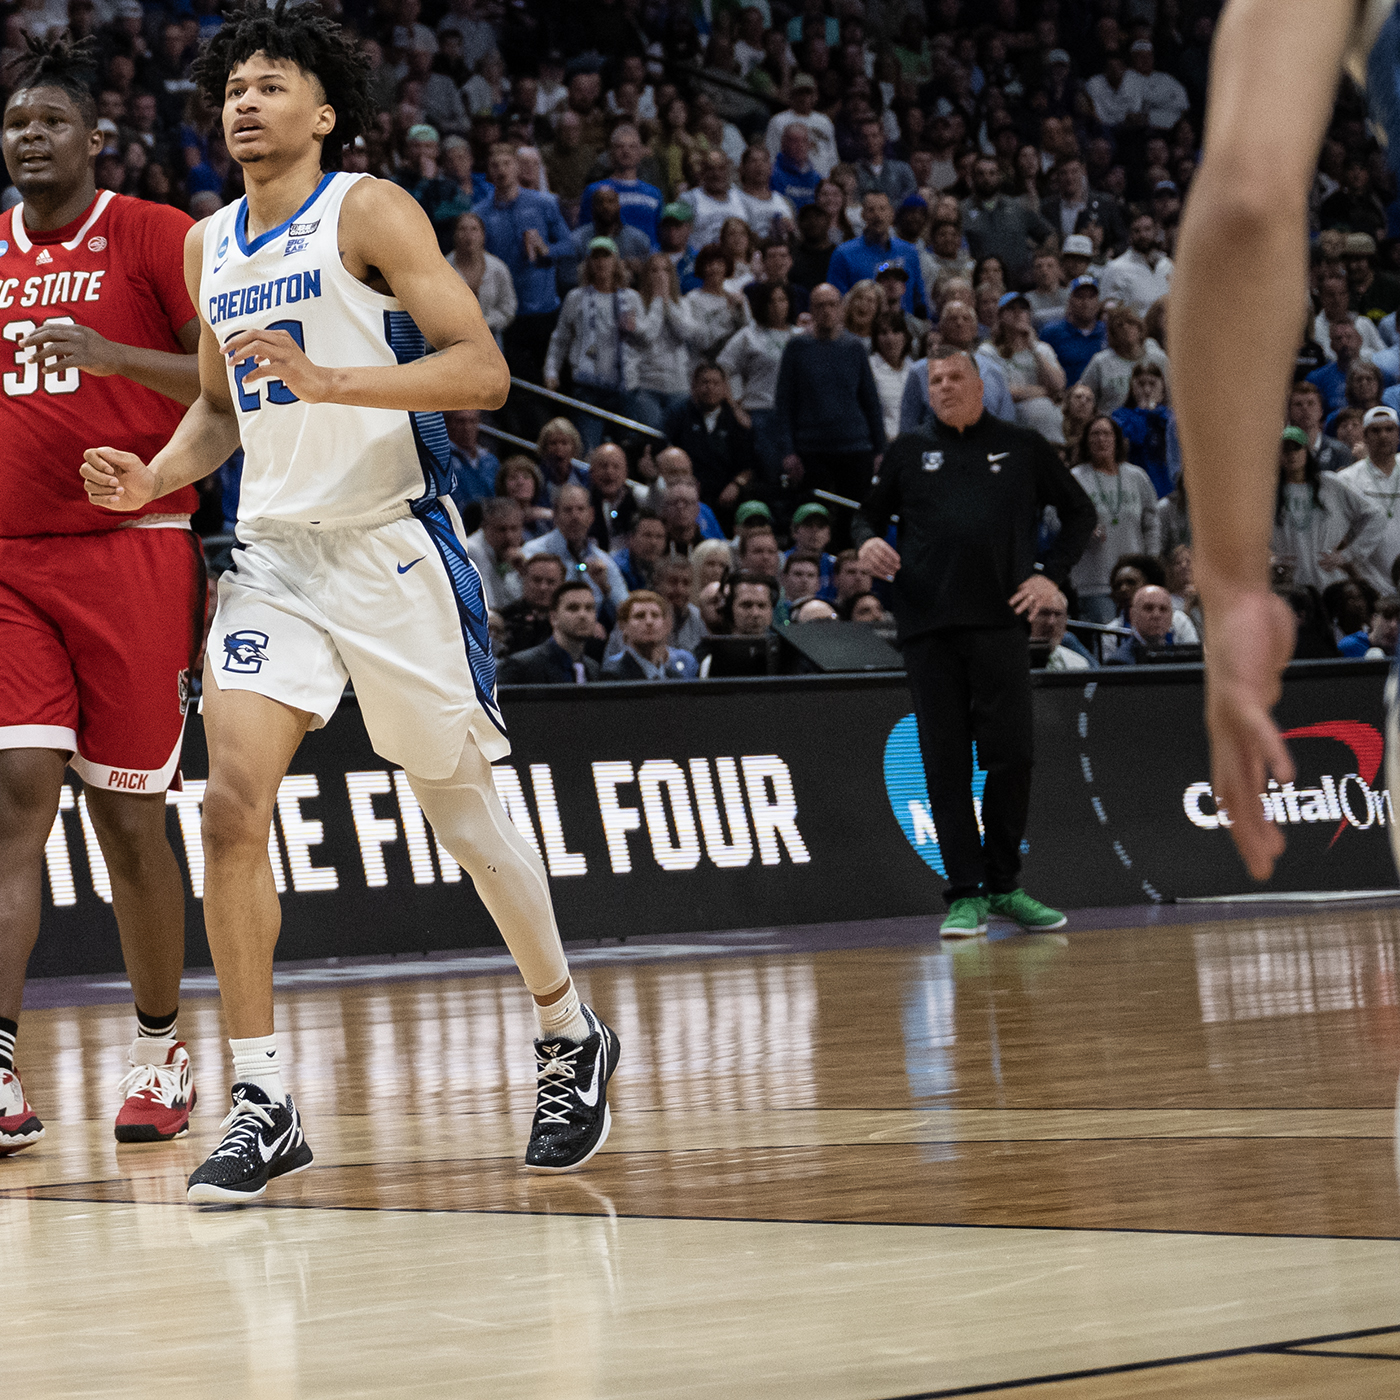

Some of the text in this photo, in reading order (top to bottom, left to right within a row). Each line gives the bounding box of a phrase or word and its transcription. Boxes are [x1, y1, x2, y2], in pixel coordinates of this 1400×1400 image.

[20, 270, 106, 308] STATE
[208, 268, 322, 325] CREIGHTON
[107, 769, 149, 791] PACK
[166, 773, 339, 899] TE
[344, 763, 589, 888] FIAL
[591, 753, 812, 875] FOUR
